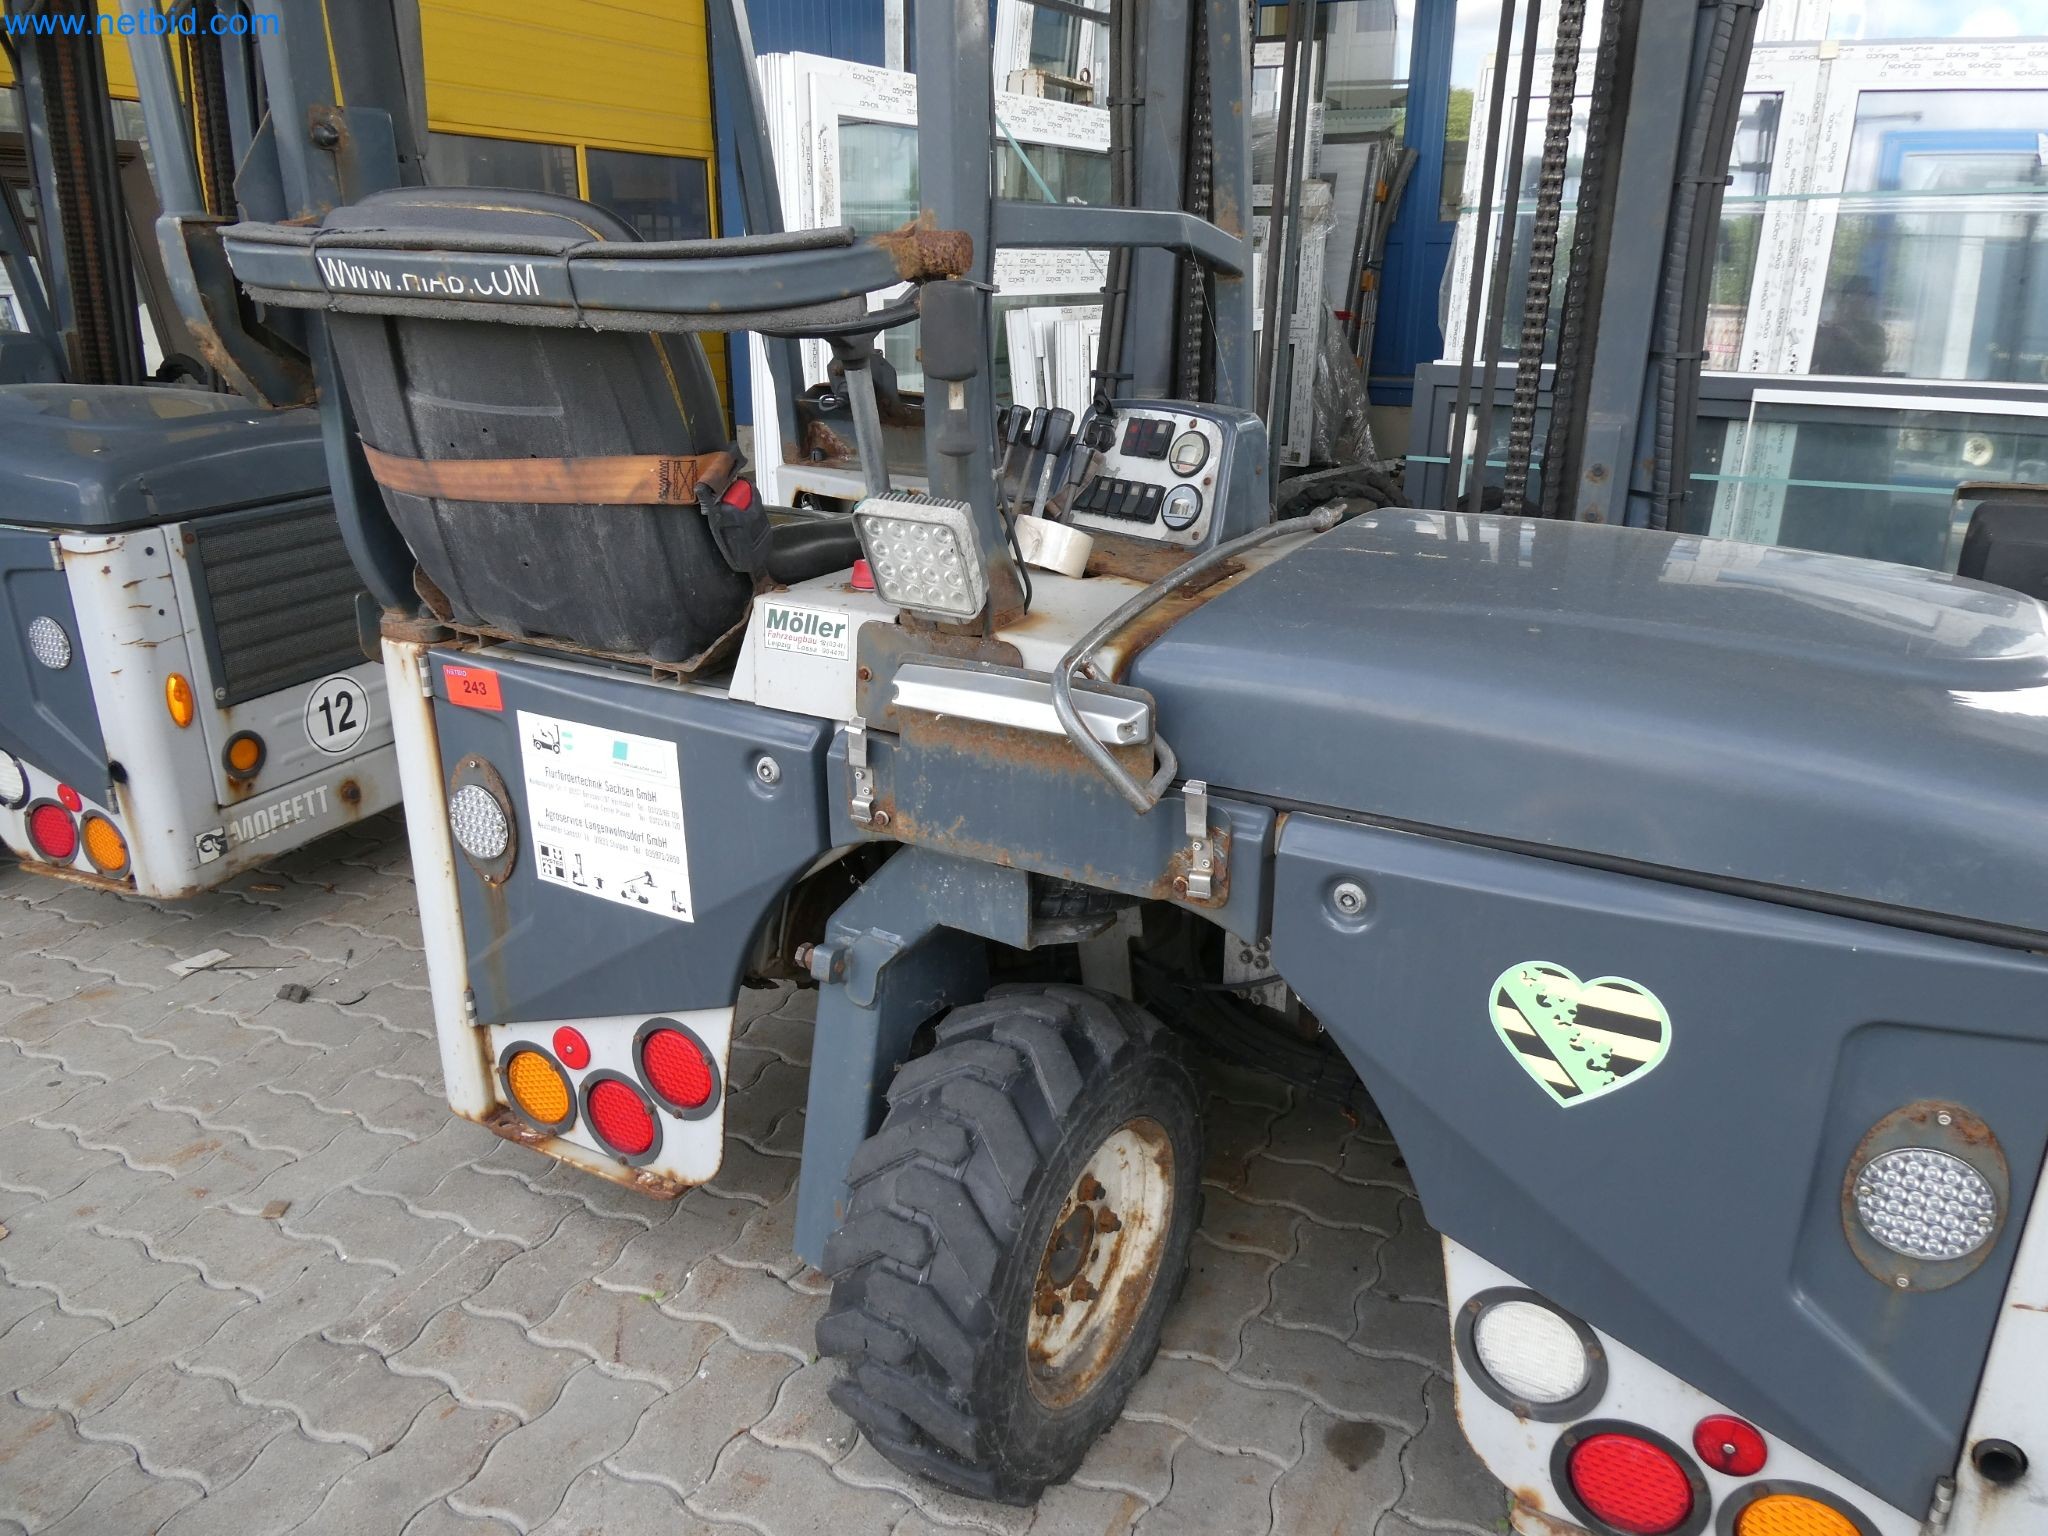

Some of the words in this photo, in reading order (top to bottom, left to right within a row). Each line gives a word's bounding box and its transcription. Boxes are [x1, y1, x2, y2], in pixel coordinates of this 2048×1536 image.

[767, 609, 846, 638] Möller
[767, 630, 818, 645] Fahrzeugbau
[767, 640, 792, 650] Leipzig
[463, 679, 487, 696] 243
[319, 691, 357, 737] 12
[604, 780, 635, 798] Sachsen
[636, 787, 657, 803] GmbH
[228, 784, 329, 845] MOFFETT
[646, 833, 668, 849] GmbH
